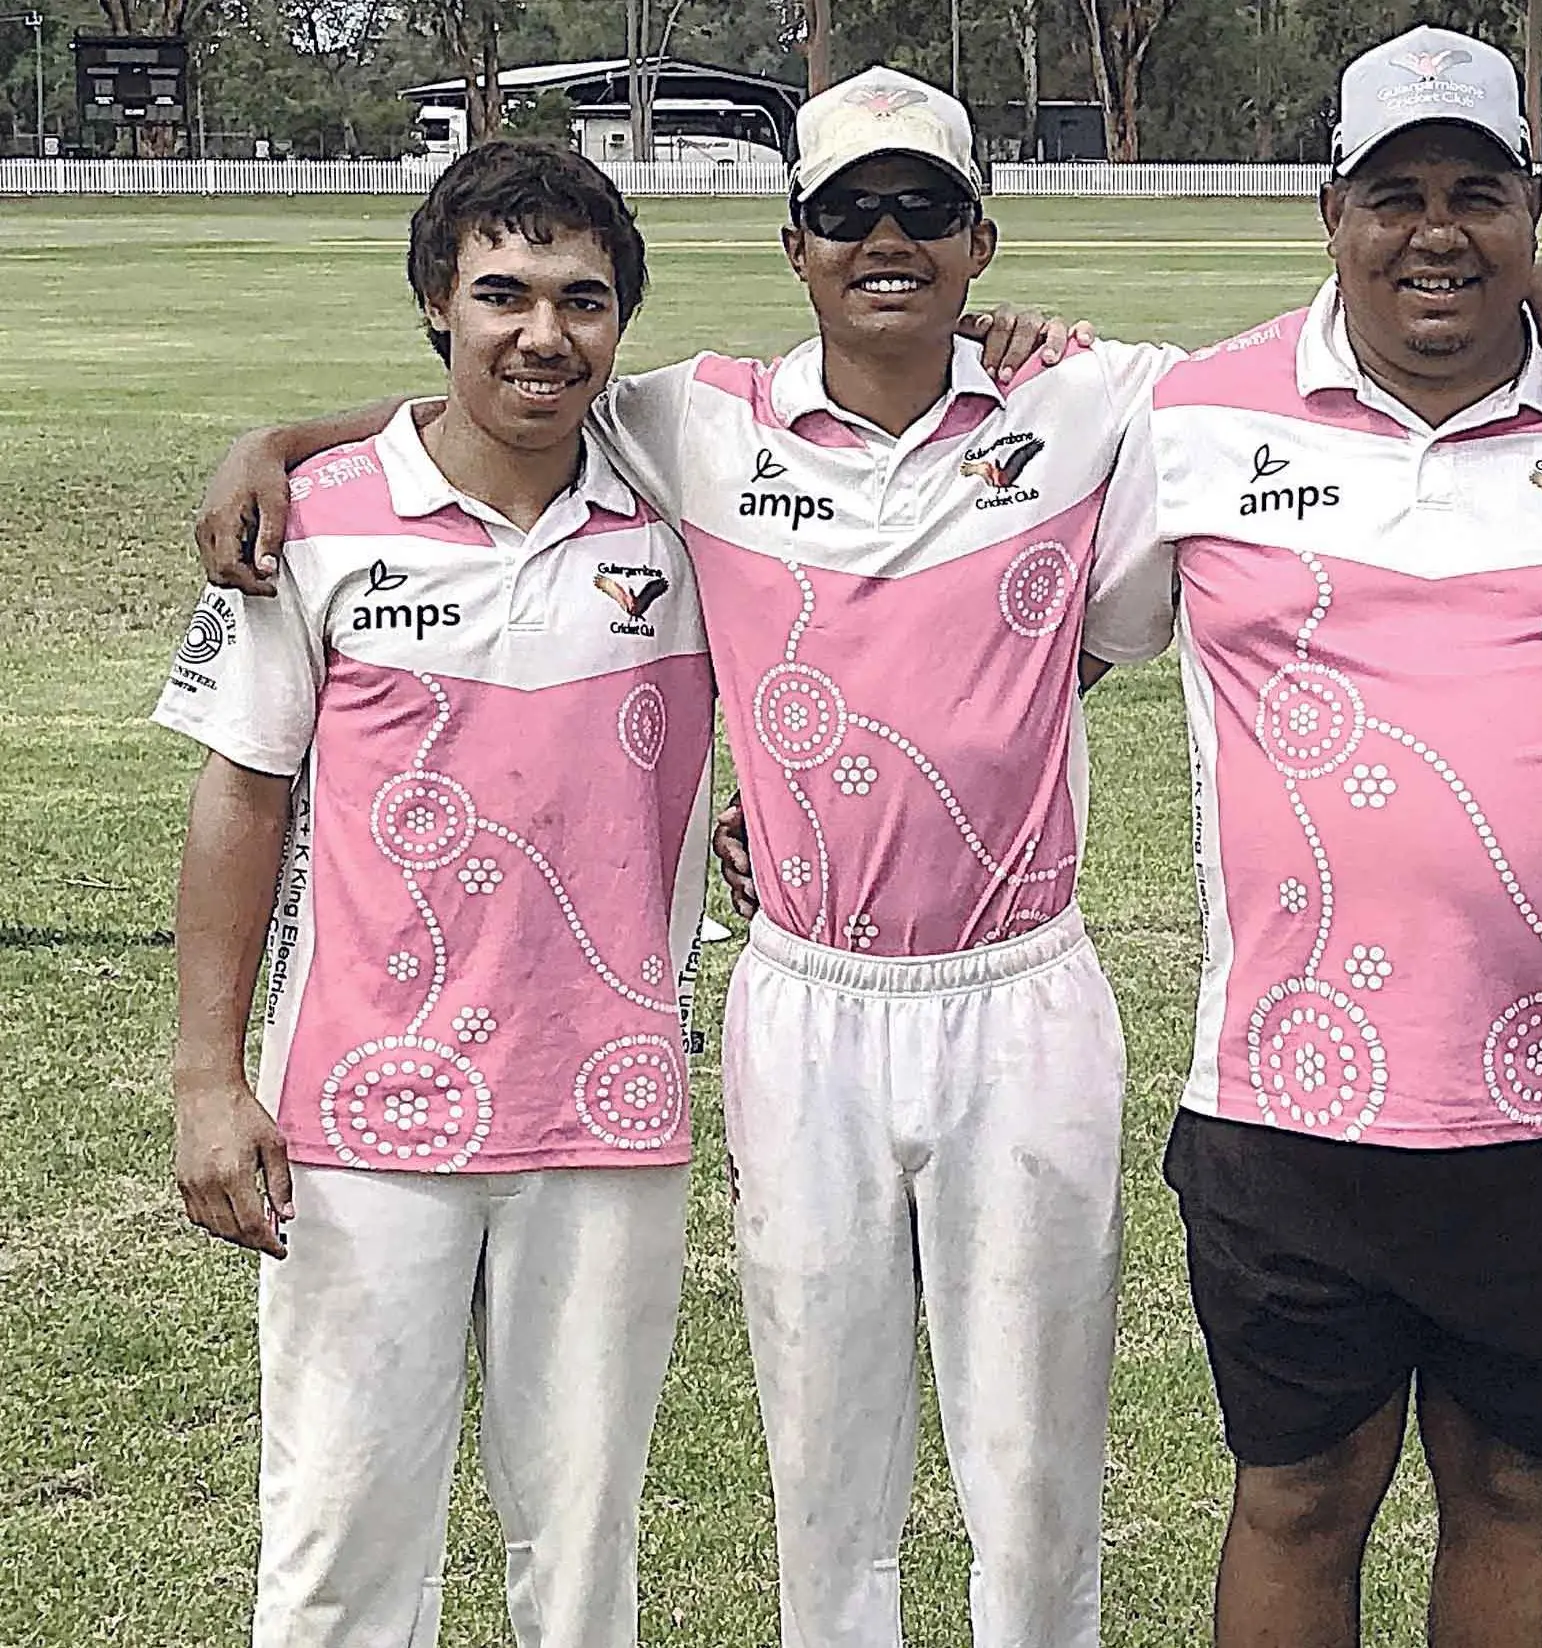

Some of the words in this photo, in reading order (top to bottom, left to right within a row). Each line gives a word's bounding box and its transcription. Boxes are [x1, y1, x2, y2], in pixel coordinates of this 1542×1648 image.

[738, 492, 835, 532] amps
[1239, 484, 1341, 521] amps
[352, 602, 462, 641] amps
[295, 842, 310, 863] K
[283, 867, 308, 919] King
[265, 923, 298, 1026] Electrical
